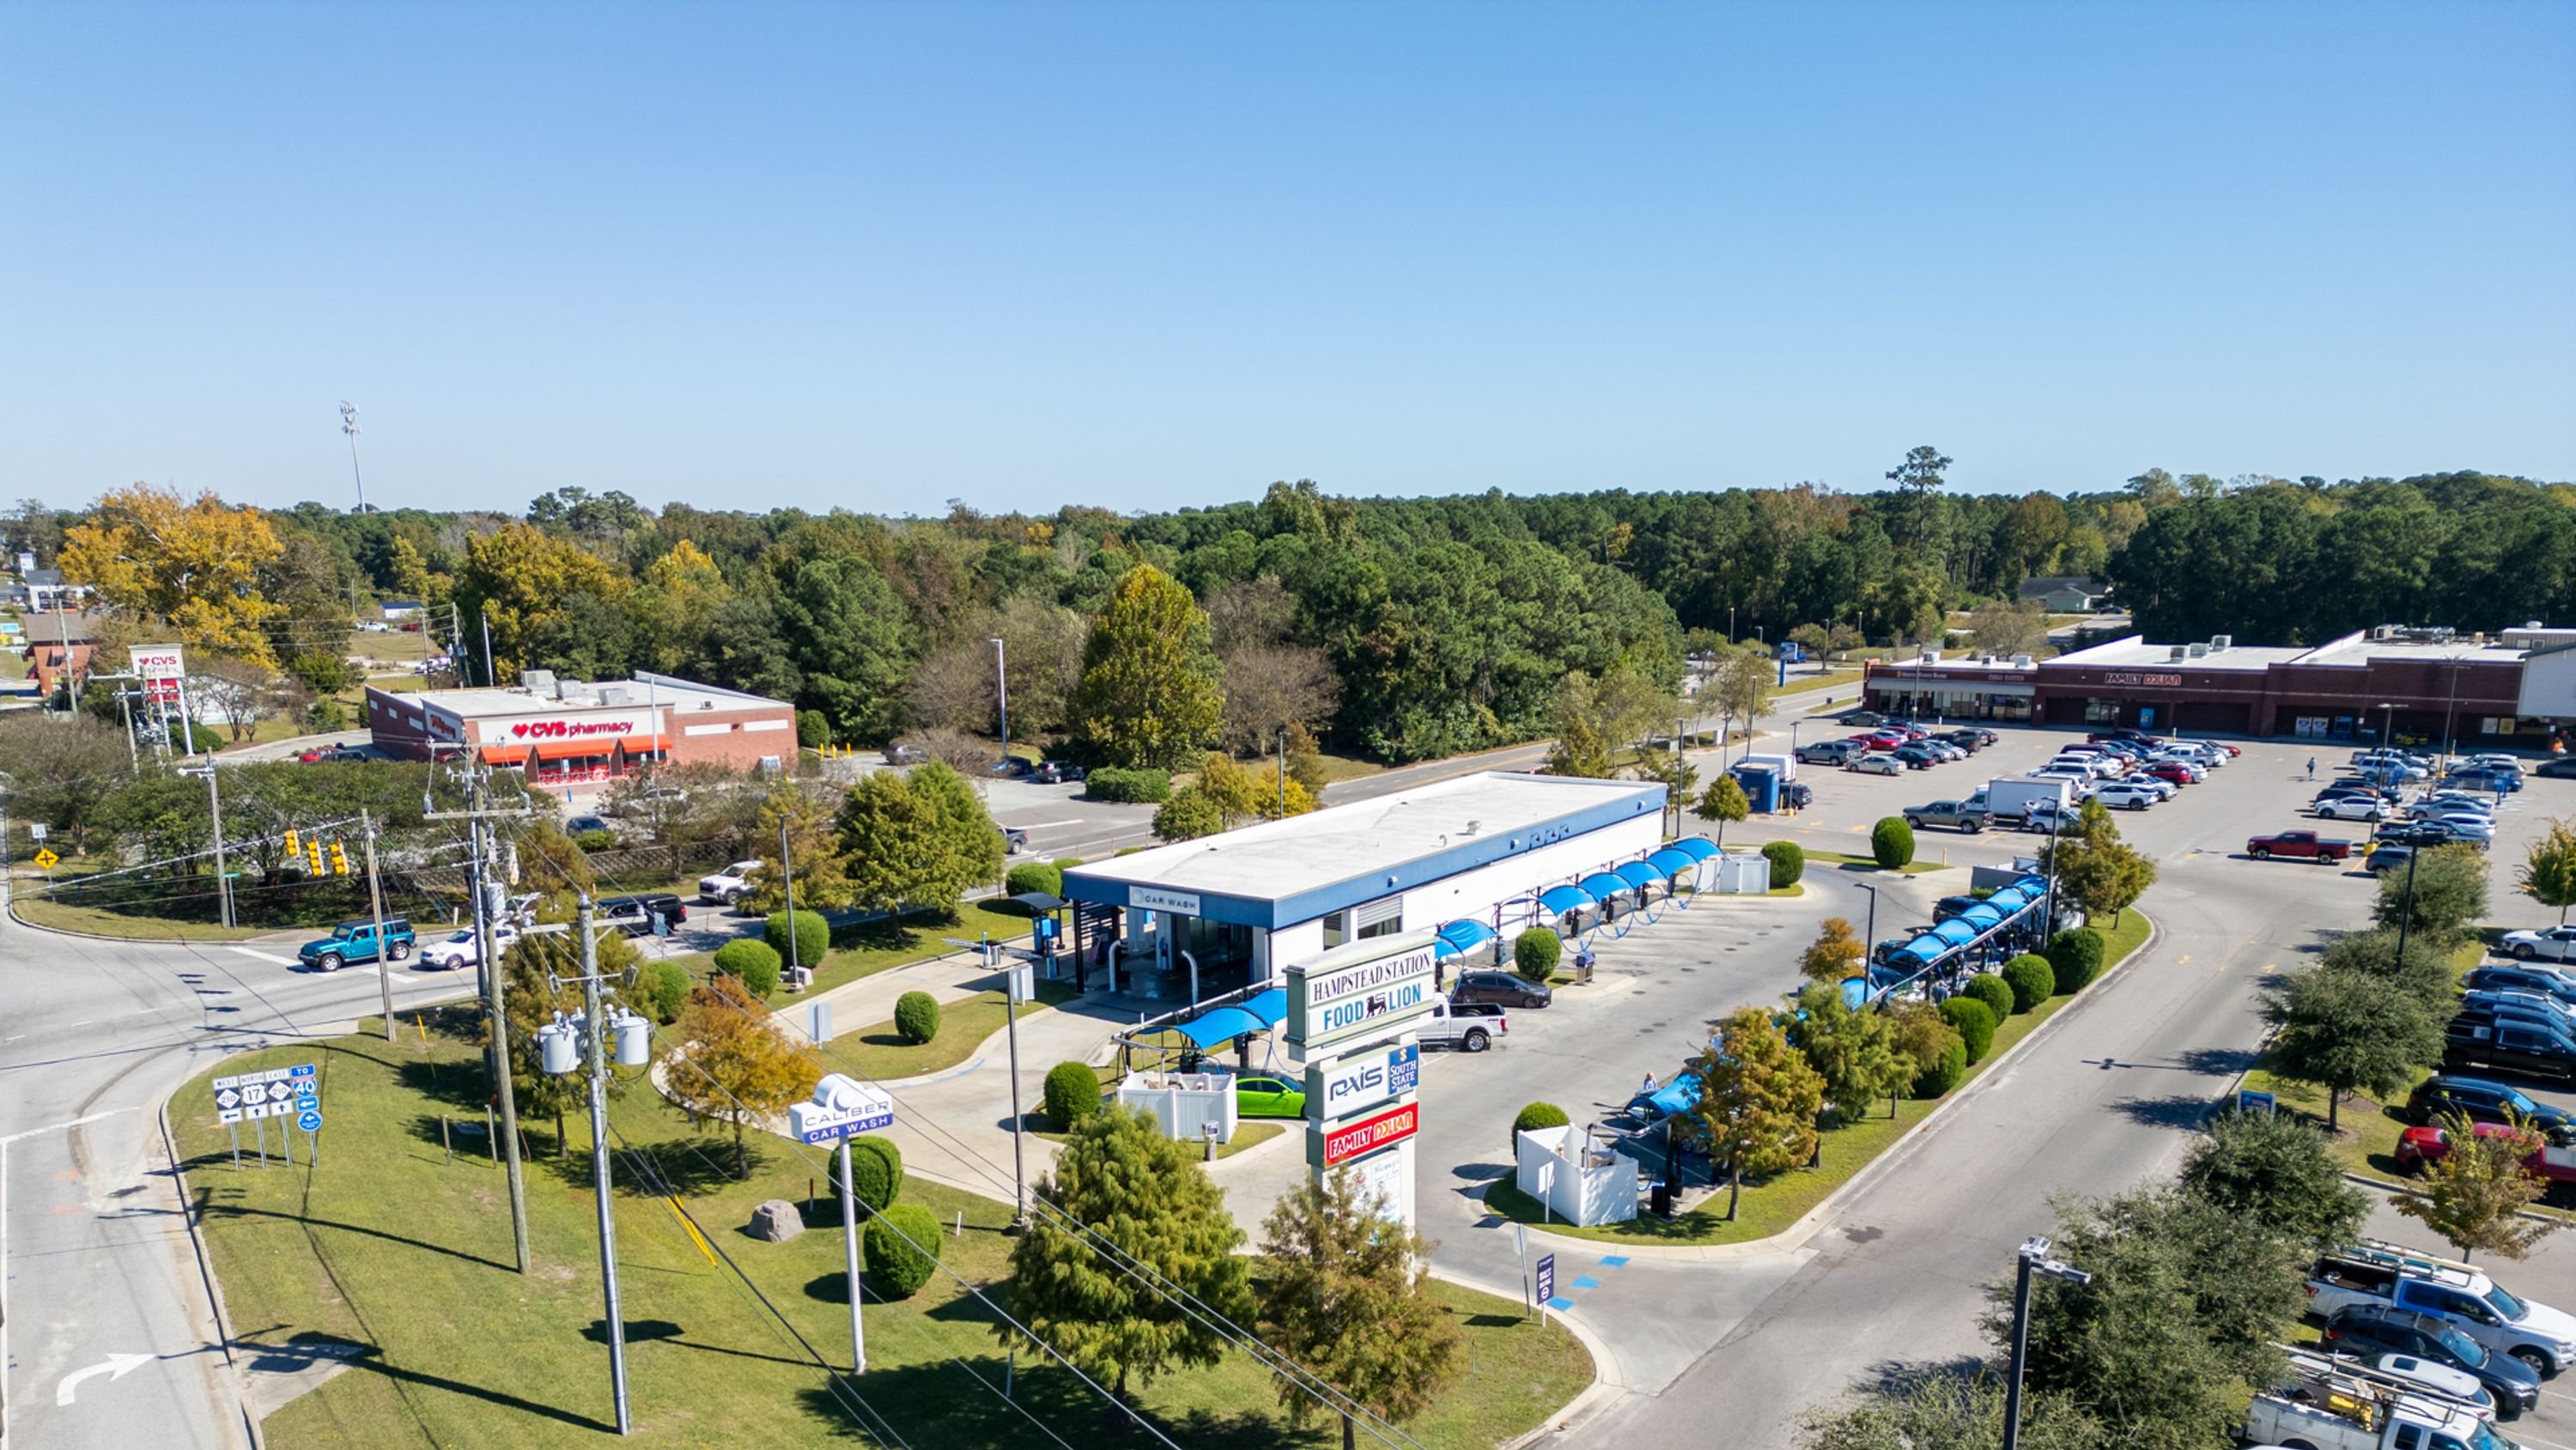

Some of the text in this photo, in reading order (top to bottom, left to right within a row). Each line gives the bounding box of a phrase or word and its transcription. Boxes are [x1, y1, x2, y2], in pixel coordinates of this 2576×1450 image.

[151, 656, 177, 665] CVS
[2105, 672, 2182, 686] FAMILY DOLLAR
[530, 721, 633, 738] CVS pharmacy
[1145, 895, 1196, 910] CAR WASH
[1314, 951, 1431, 1002] HAMPSTEAD STATION
[1323, 982, 1421, 1030] FOOD LION
[269, 1071, 286, 1079] EAST
[1390, 1060, 1417, 1077] SOUTH
[295, 1081, 315, 1094] 40
[1391, 1071, 1415, 1089] STATE
[247, 1089, 260, 1101] 17
[272, 1086, 287, 1095] 210
[221, 1095, 236, 1103] 210
[805, 1101, 889, 1126] CALIBER
[809, 1116, 888, 1141] CAR WASH
[1328, 1111, 1414, 1158] FAMILY DOLLAR
